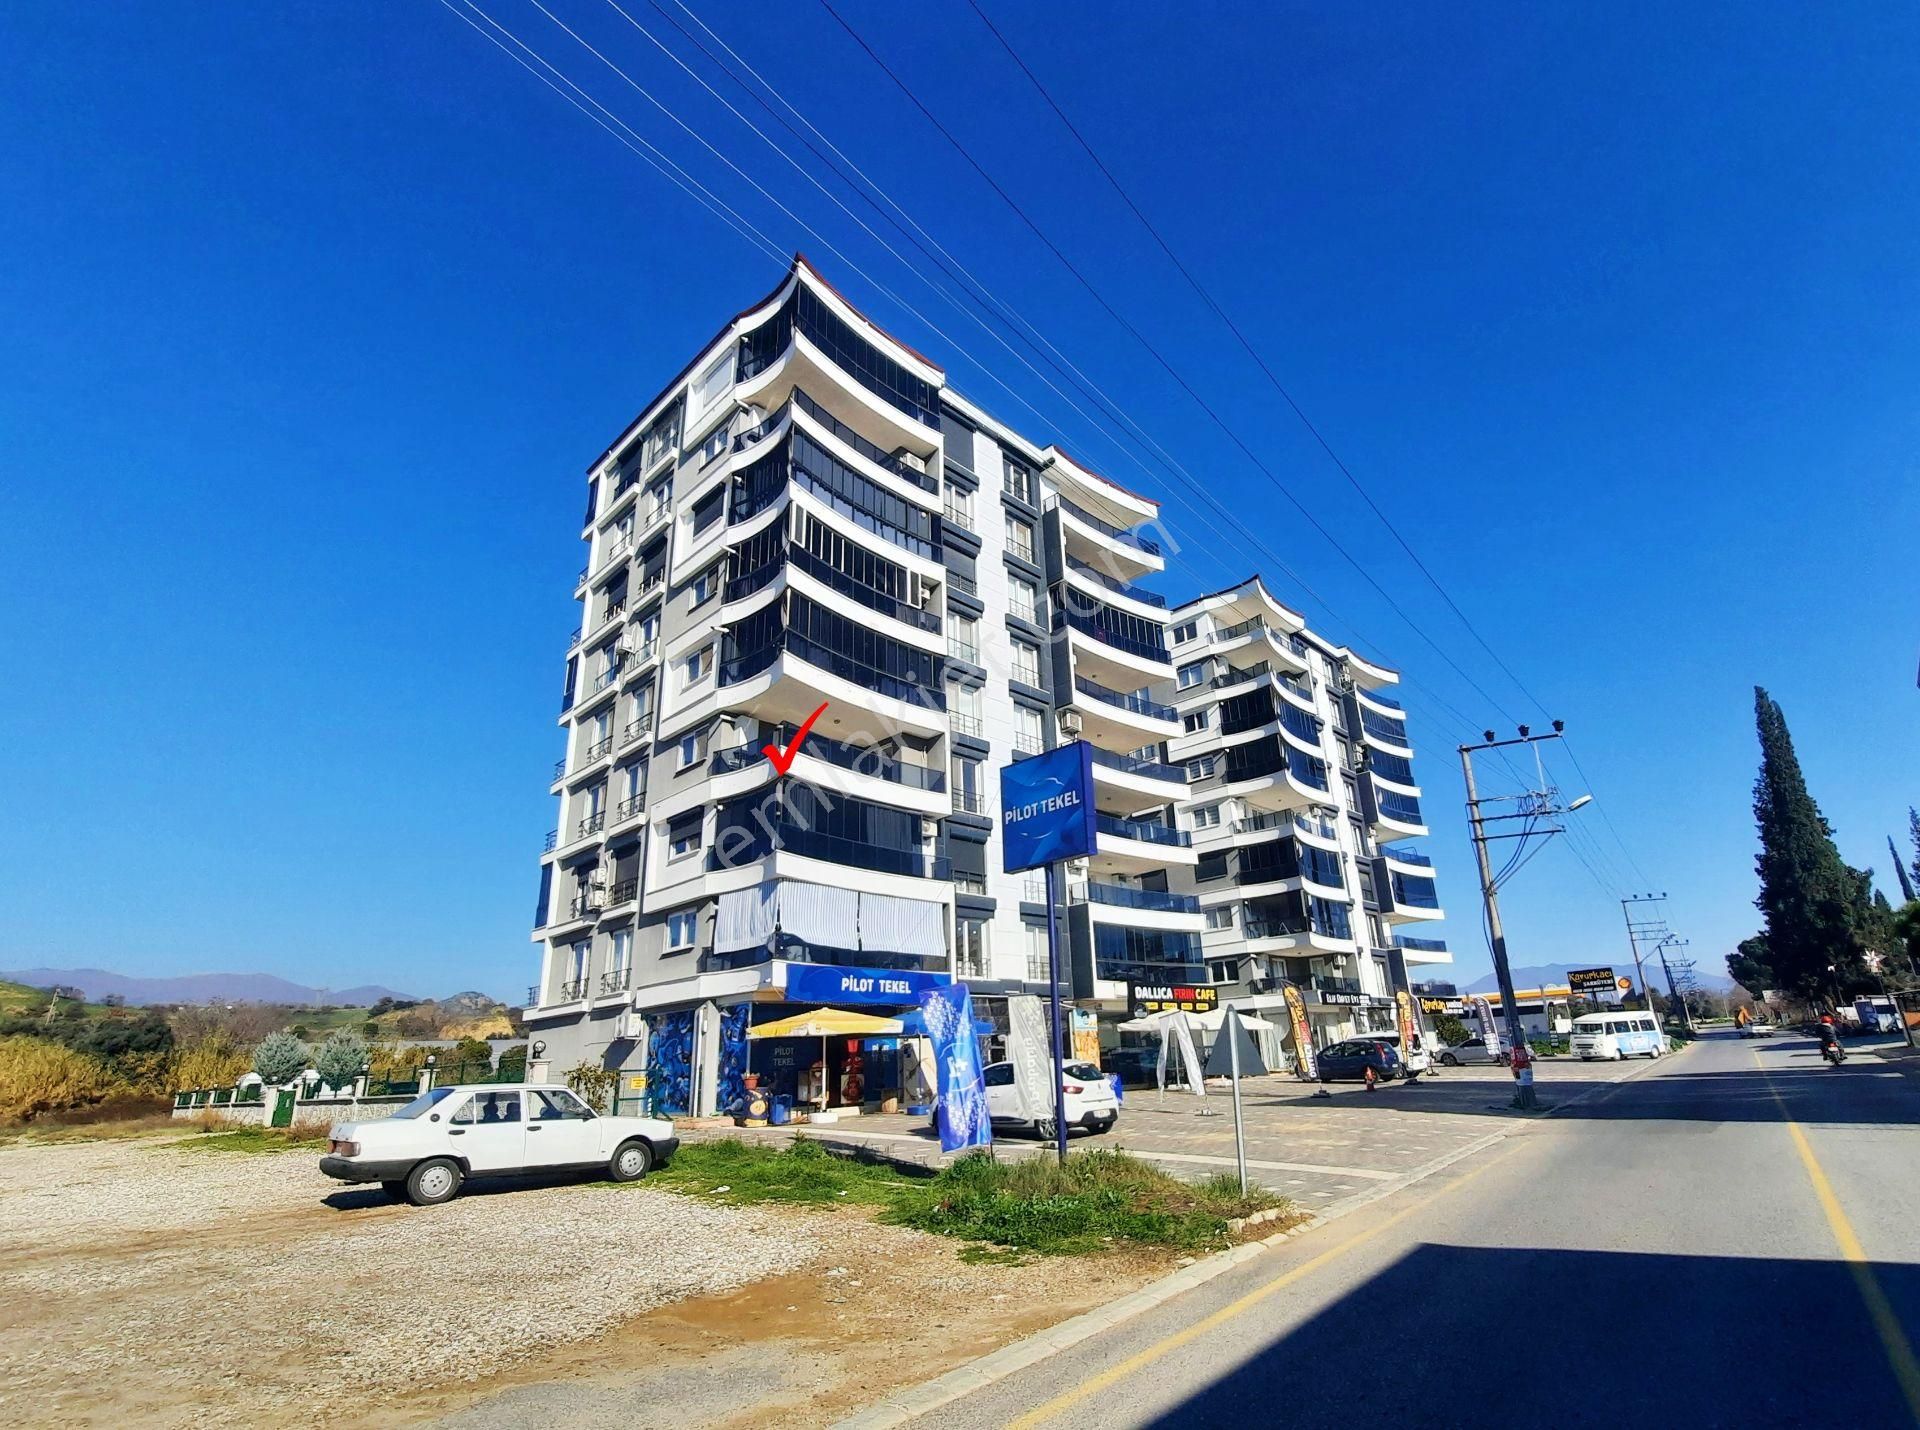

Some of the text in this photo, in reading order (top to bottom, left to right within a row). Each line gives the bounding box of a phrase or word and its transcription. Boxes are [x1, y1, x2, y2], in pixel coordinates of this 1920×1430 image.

[1004, 790, 1081, 825] PİLOT TEKEL
[841, 975, 912, 994] PİLOT TEKEL
[1195, 988, 1216, 1001] CAFE
